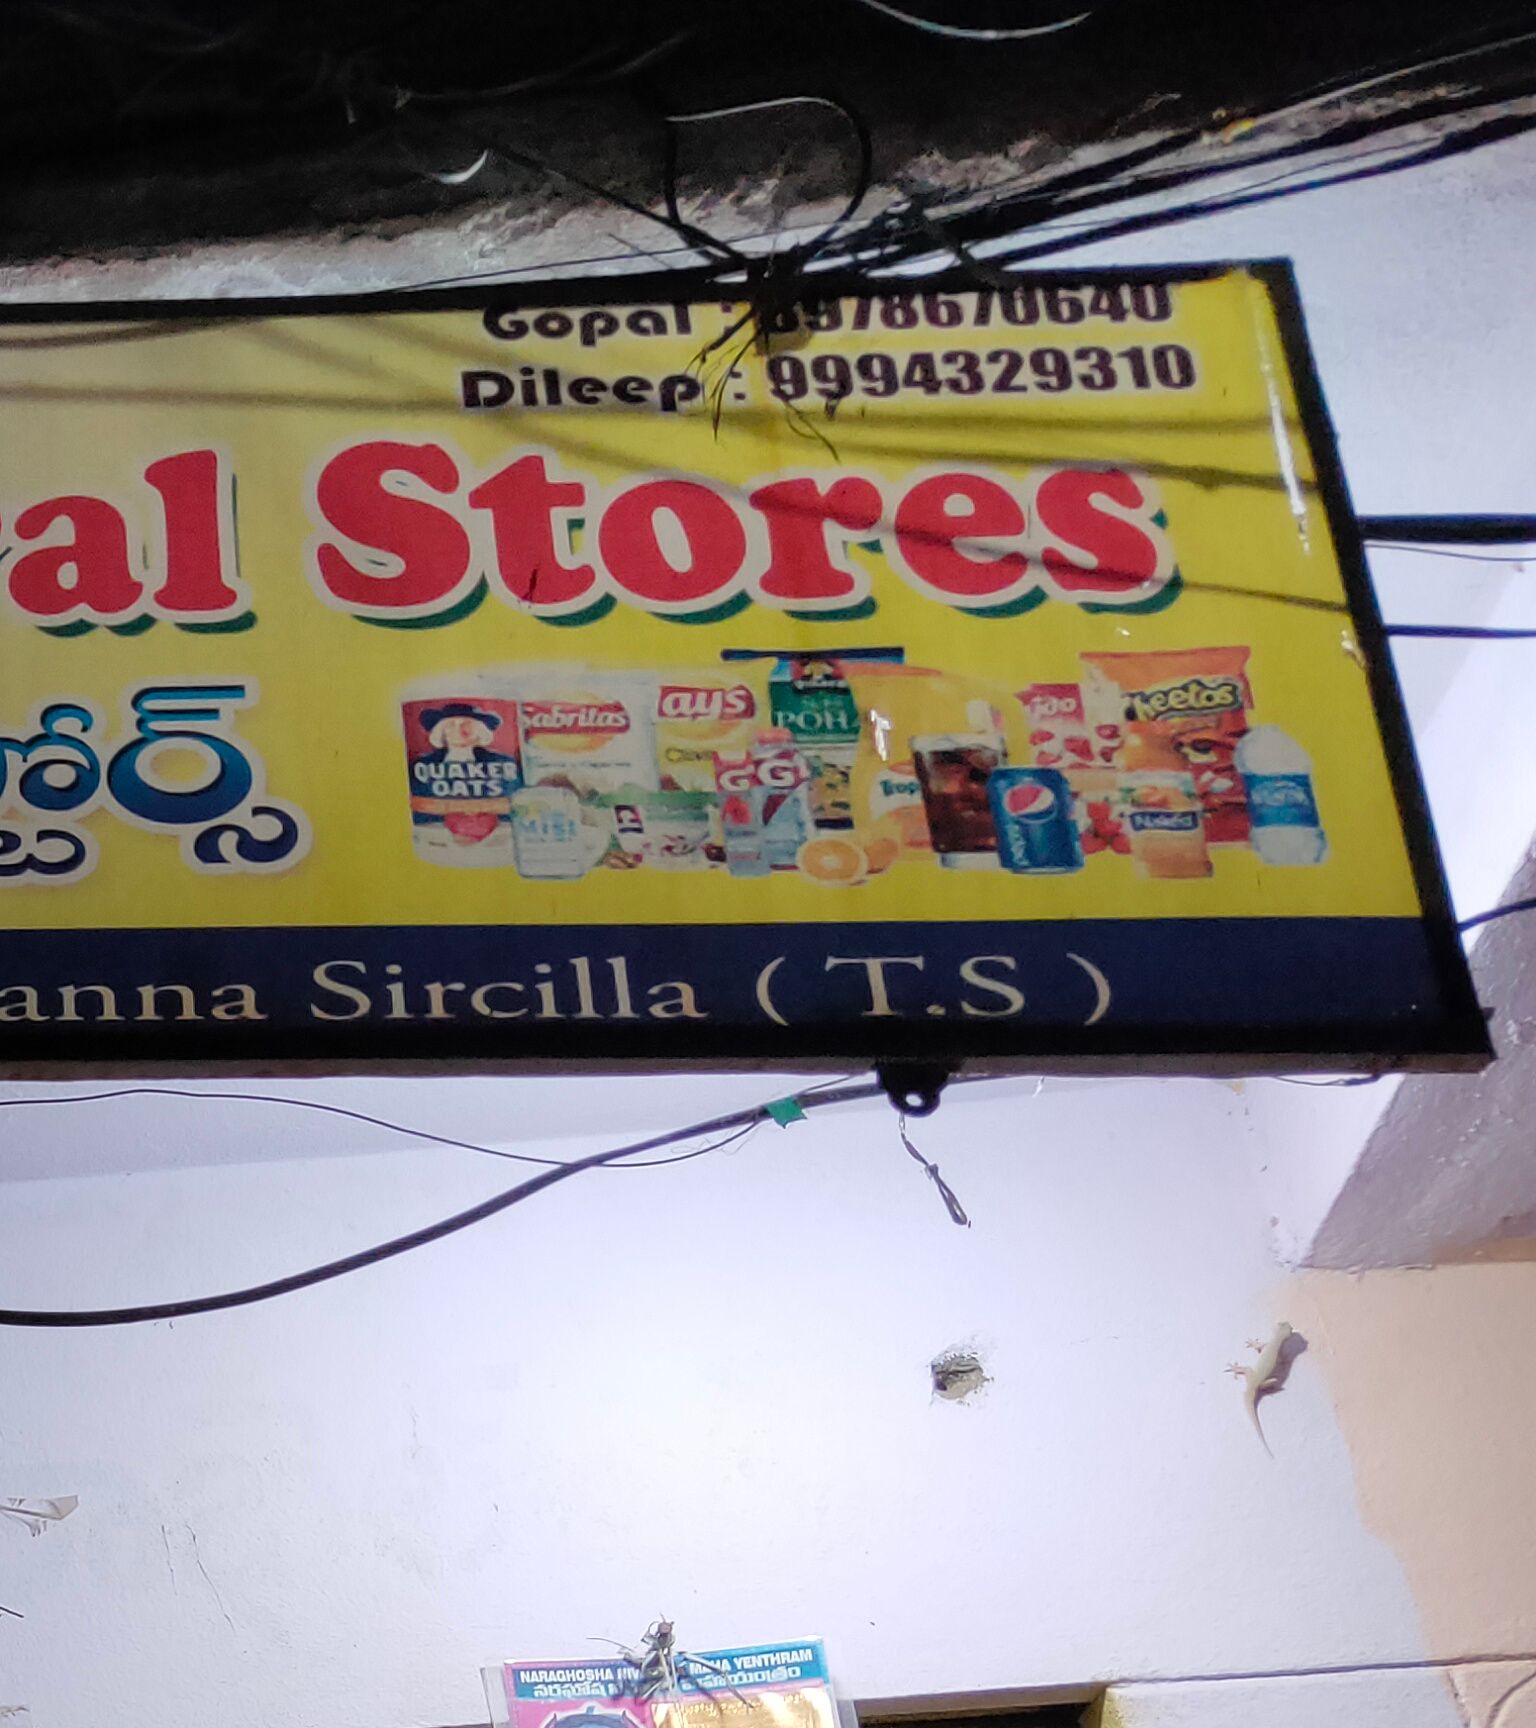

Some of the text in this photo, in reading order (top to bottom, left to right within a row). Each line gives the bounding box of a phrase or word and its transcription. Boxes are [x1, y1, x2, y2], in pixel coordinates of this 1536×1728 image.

[483, 297, 692, 348] Gopal
[459, 367, 702, 413] Dileep
[767, 345, 1196, 402] 9994329310
[308, 438, 1170, 620] Stores
[661, 686, 751, 718] ays
[413, 760, 519, 786] QUAKER
[431, 778, 503, 798] OATS
[310, 956, 710, 1022] Sircilla
[732, 1646, 814, 1672] YENTHRAM
